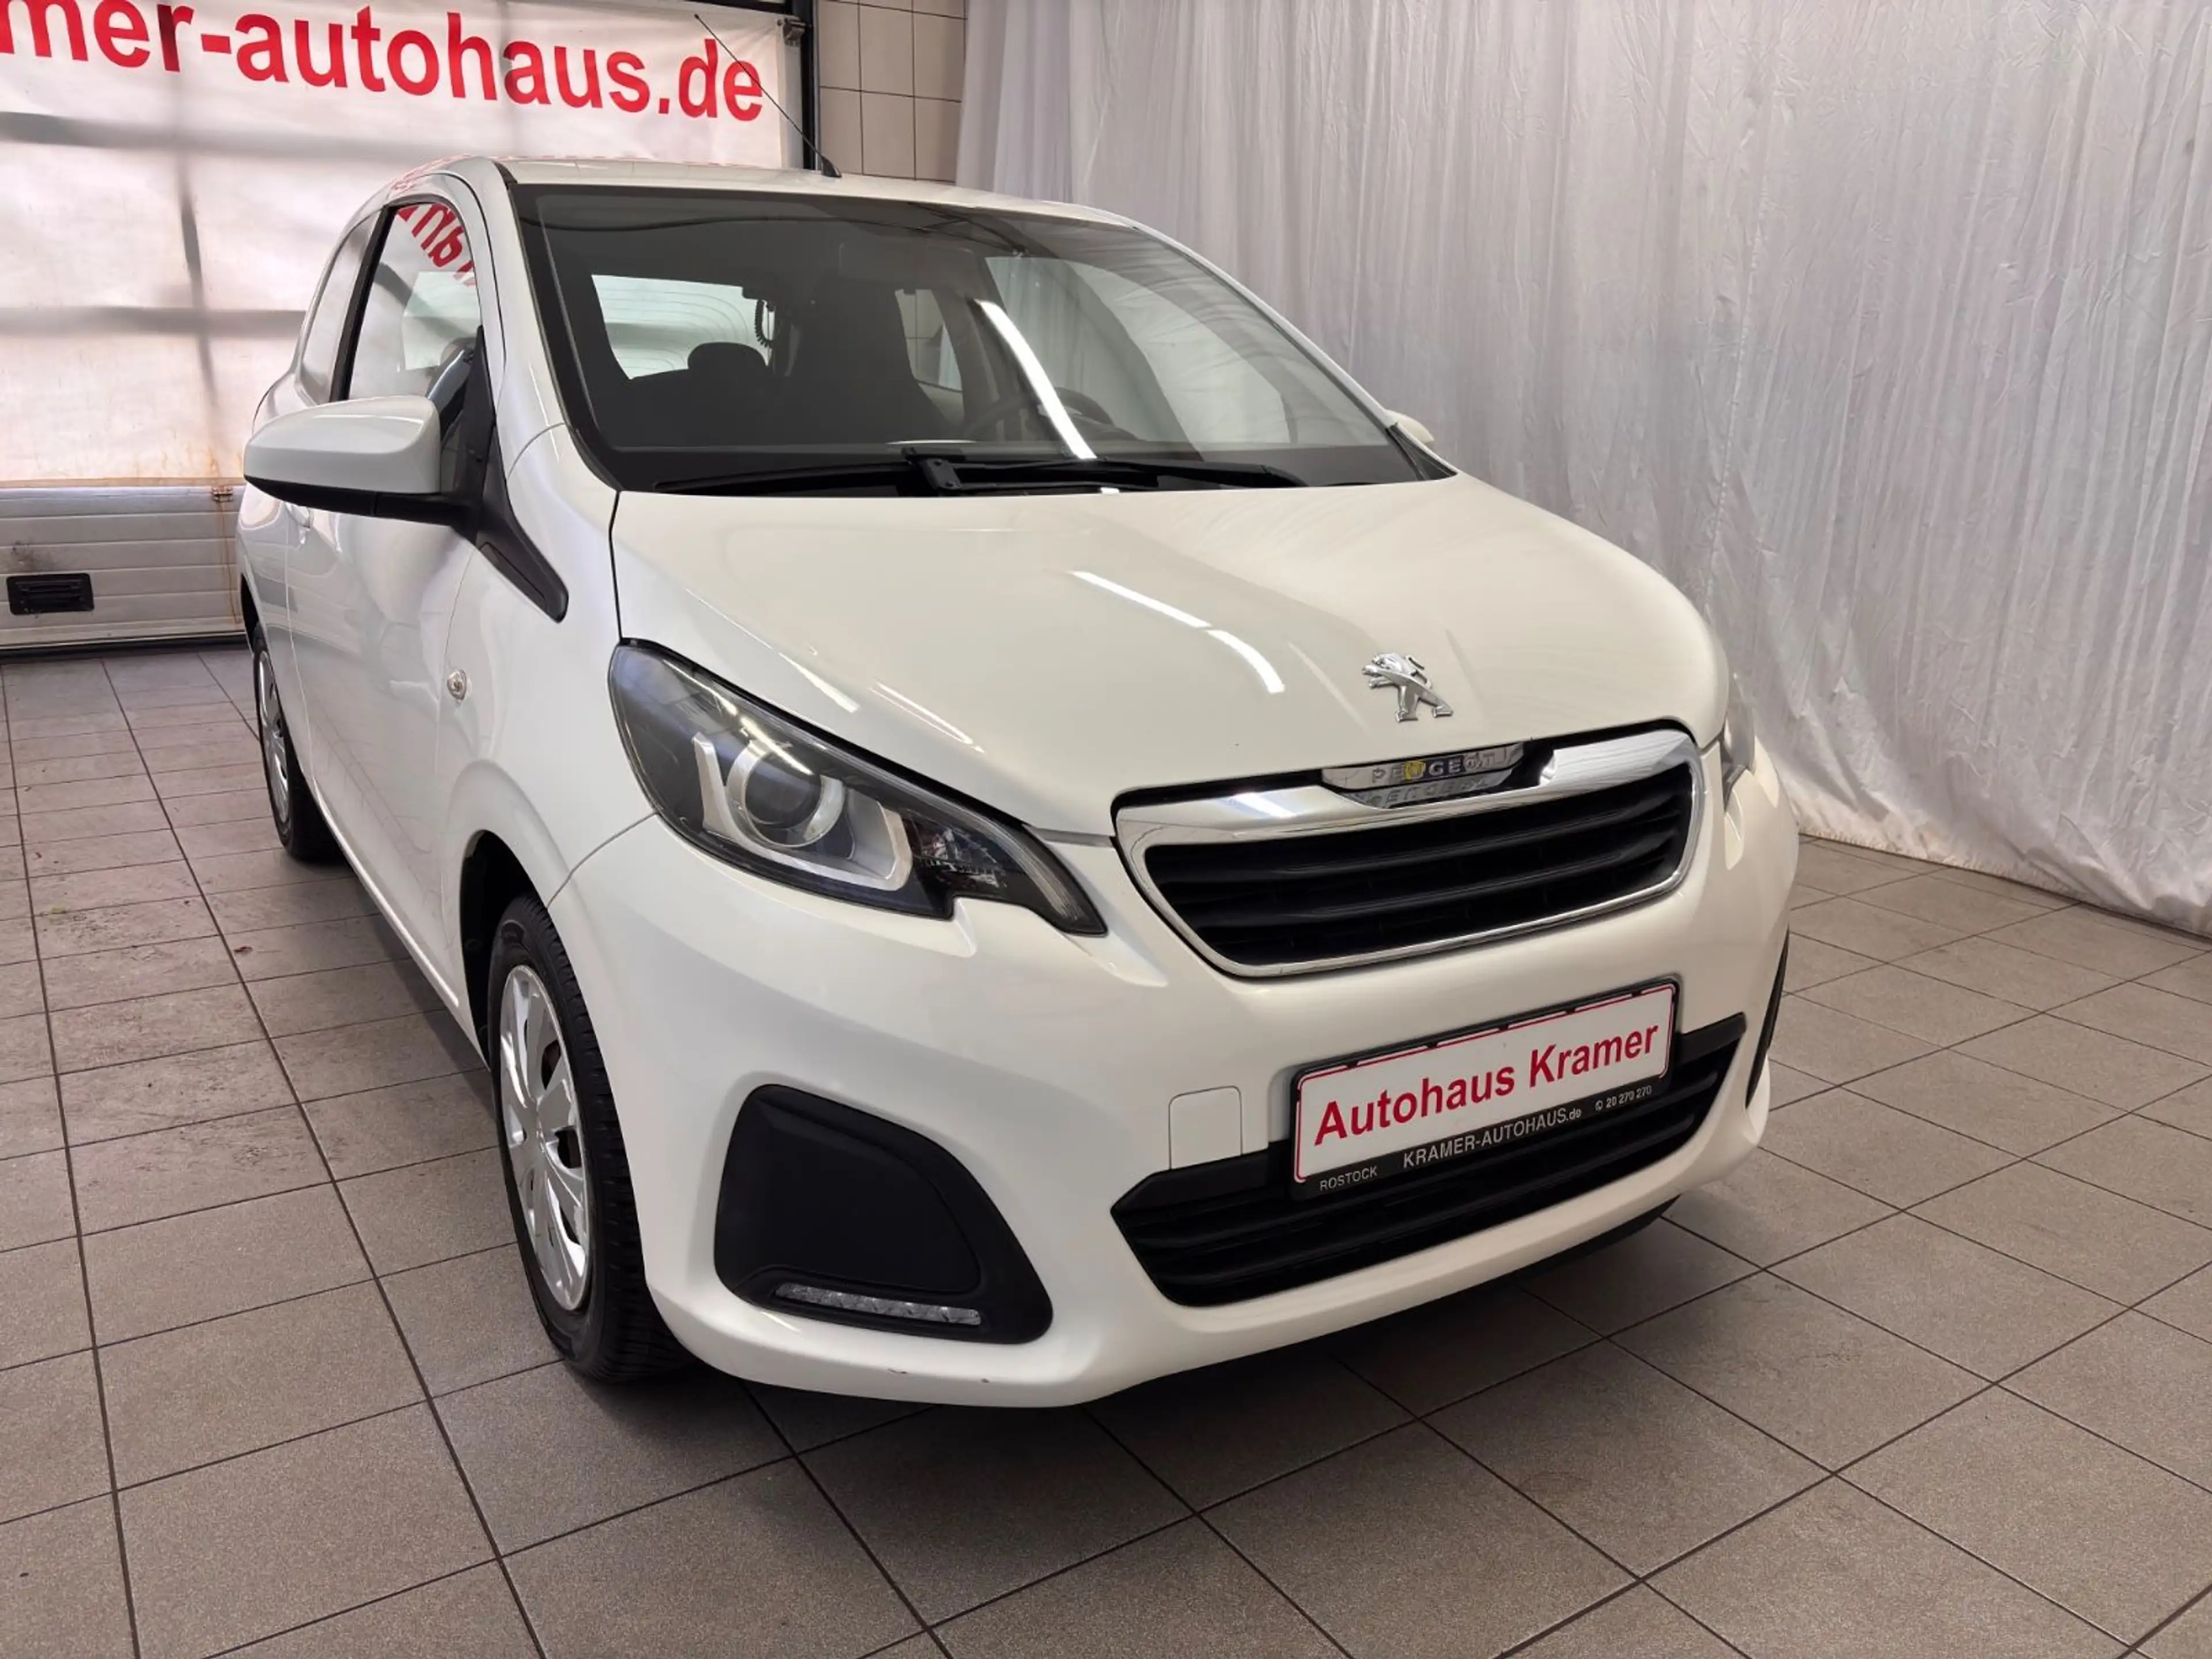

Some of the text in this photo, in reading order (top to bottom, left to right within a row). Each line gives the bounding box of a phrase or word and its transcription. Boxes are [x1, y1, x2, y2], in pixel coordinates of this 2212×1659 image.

[0, 0, 763, 122] mer-autohaus.de
[1314, 1024, 1659, 1146] Autohaus Kramer
[1319, 1165, 1378, 1191] ROSTOCK
[1403, 1107, 1582, 1169] KRAMER-AUTOHAUS.de
